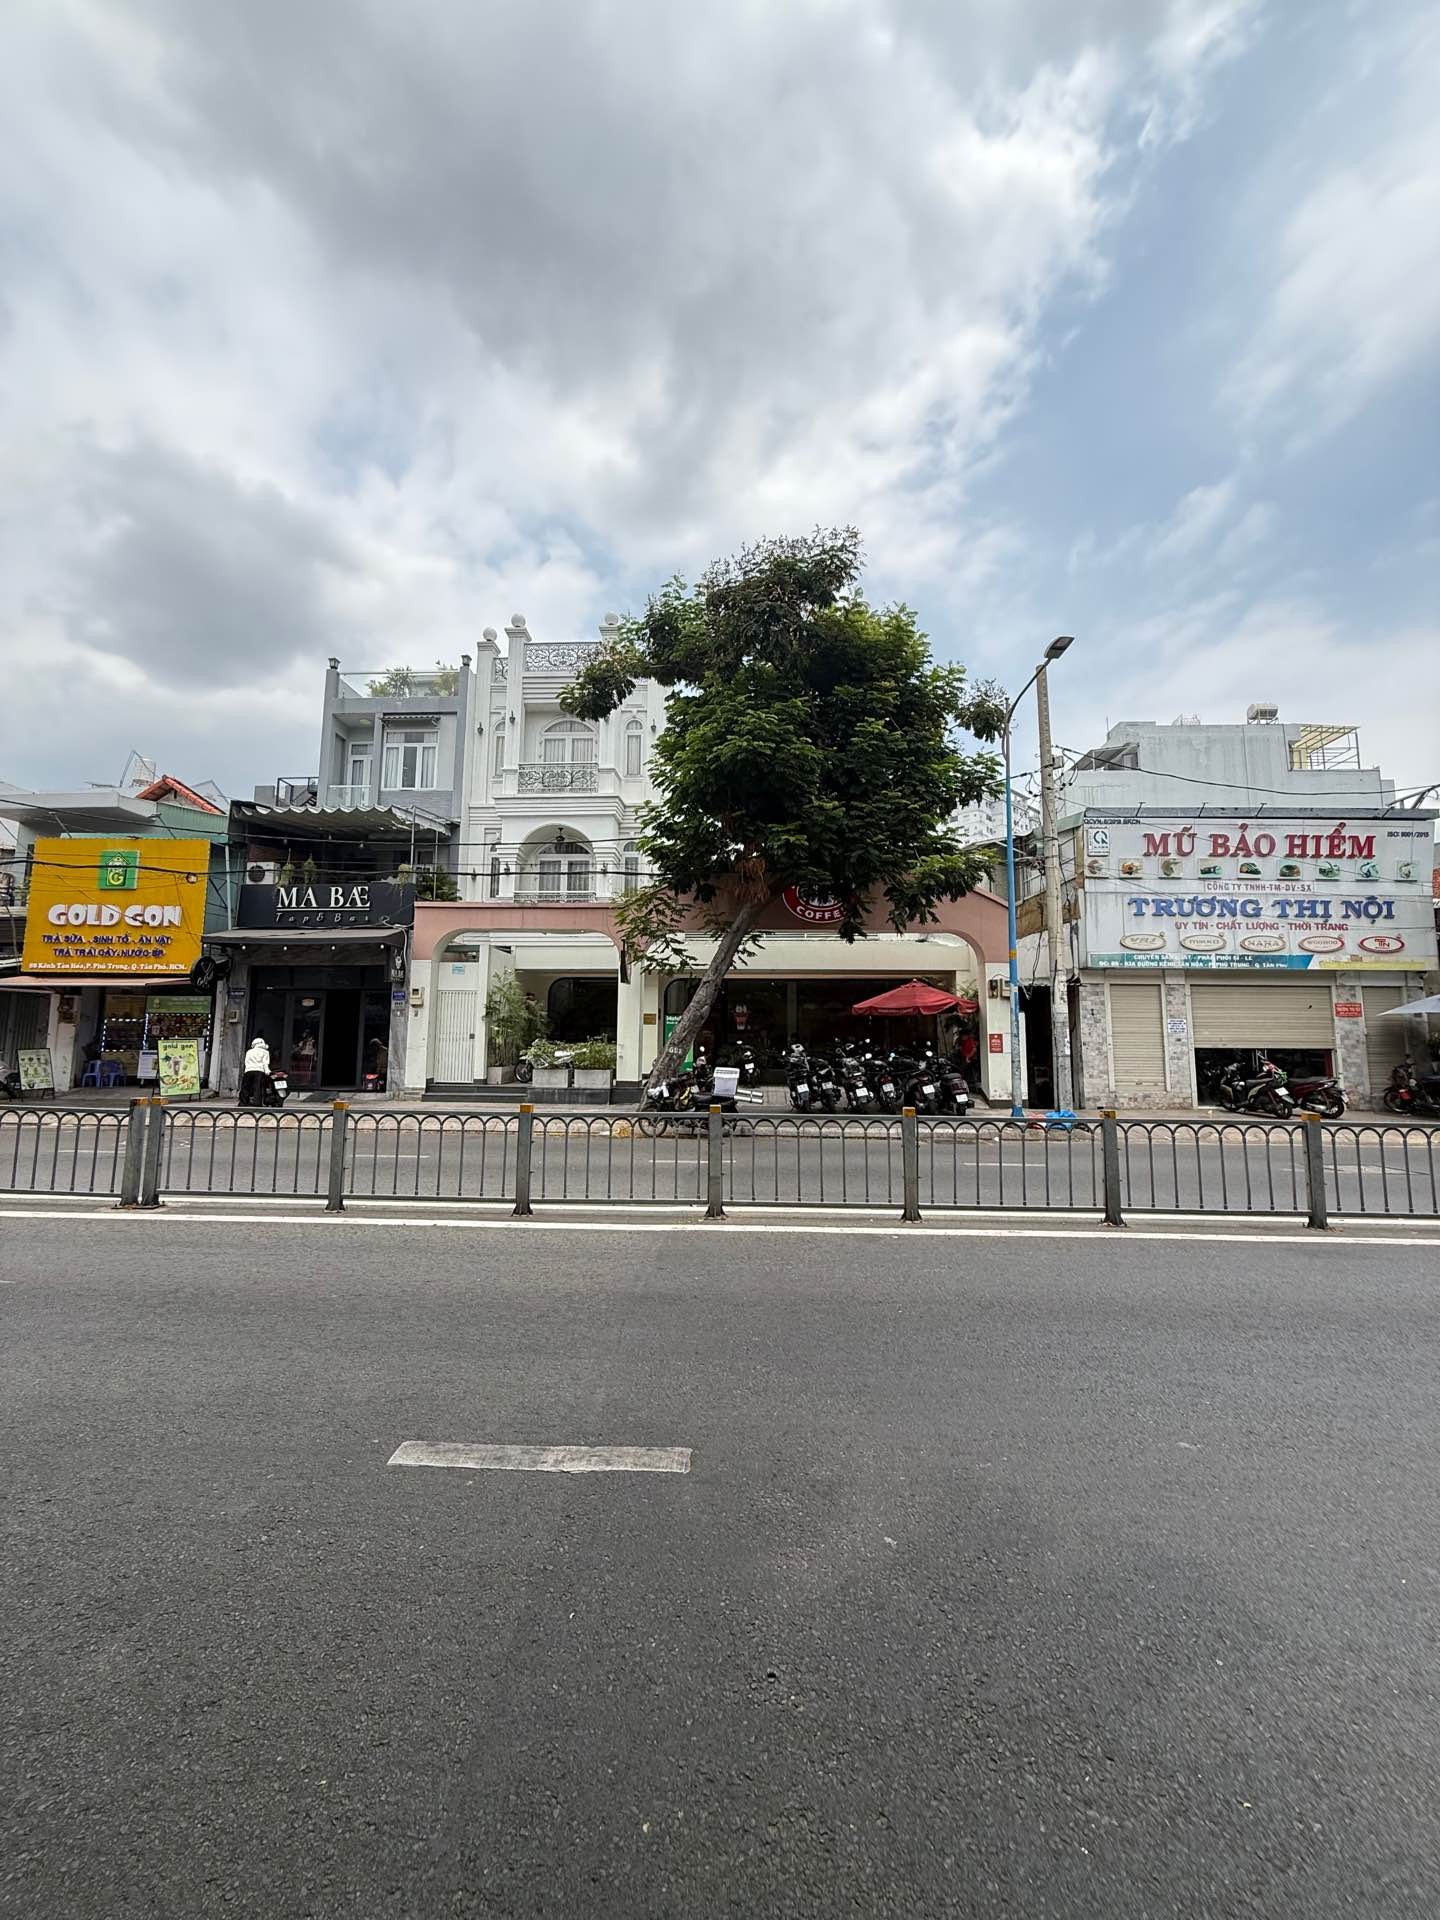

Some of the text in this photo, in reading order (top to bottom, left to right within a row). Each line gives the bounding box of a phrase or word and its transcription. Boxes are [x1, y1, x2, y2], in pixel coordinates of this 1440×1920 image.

[1142, 822, 1376, 859] MŨ BẢO HIỂM
[1206, 881, 1230, 891] CÔNG
[1232, 883, 1242, 891] TY
[276, 886, 318, 908] MA
[48, 903, 121, 926] GOLD
[1127, 895, 1396, 925] TRƯƠNG THỊ NỘI
[1175, 921, 1189, 930] UY
[1192, 919, 1209, 930] TÍN
[1216, 919, 1243, 930] CHẤT
[1246, 920, 1280, 932] LƯỢNG
[1314, 921, 1349, 931] TRANG
[42, 933, 61, 944] TRÀ
[93, 935, 116, 943] SINH
[54, 947, 73, 957] TRÀ
